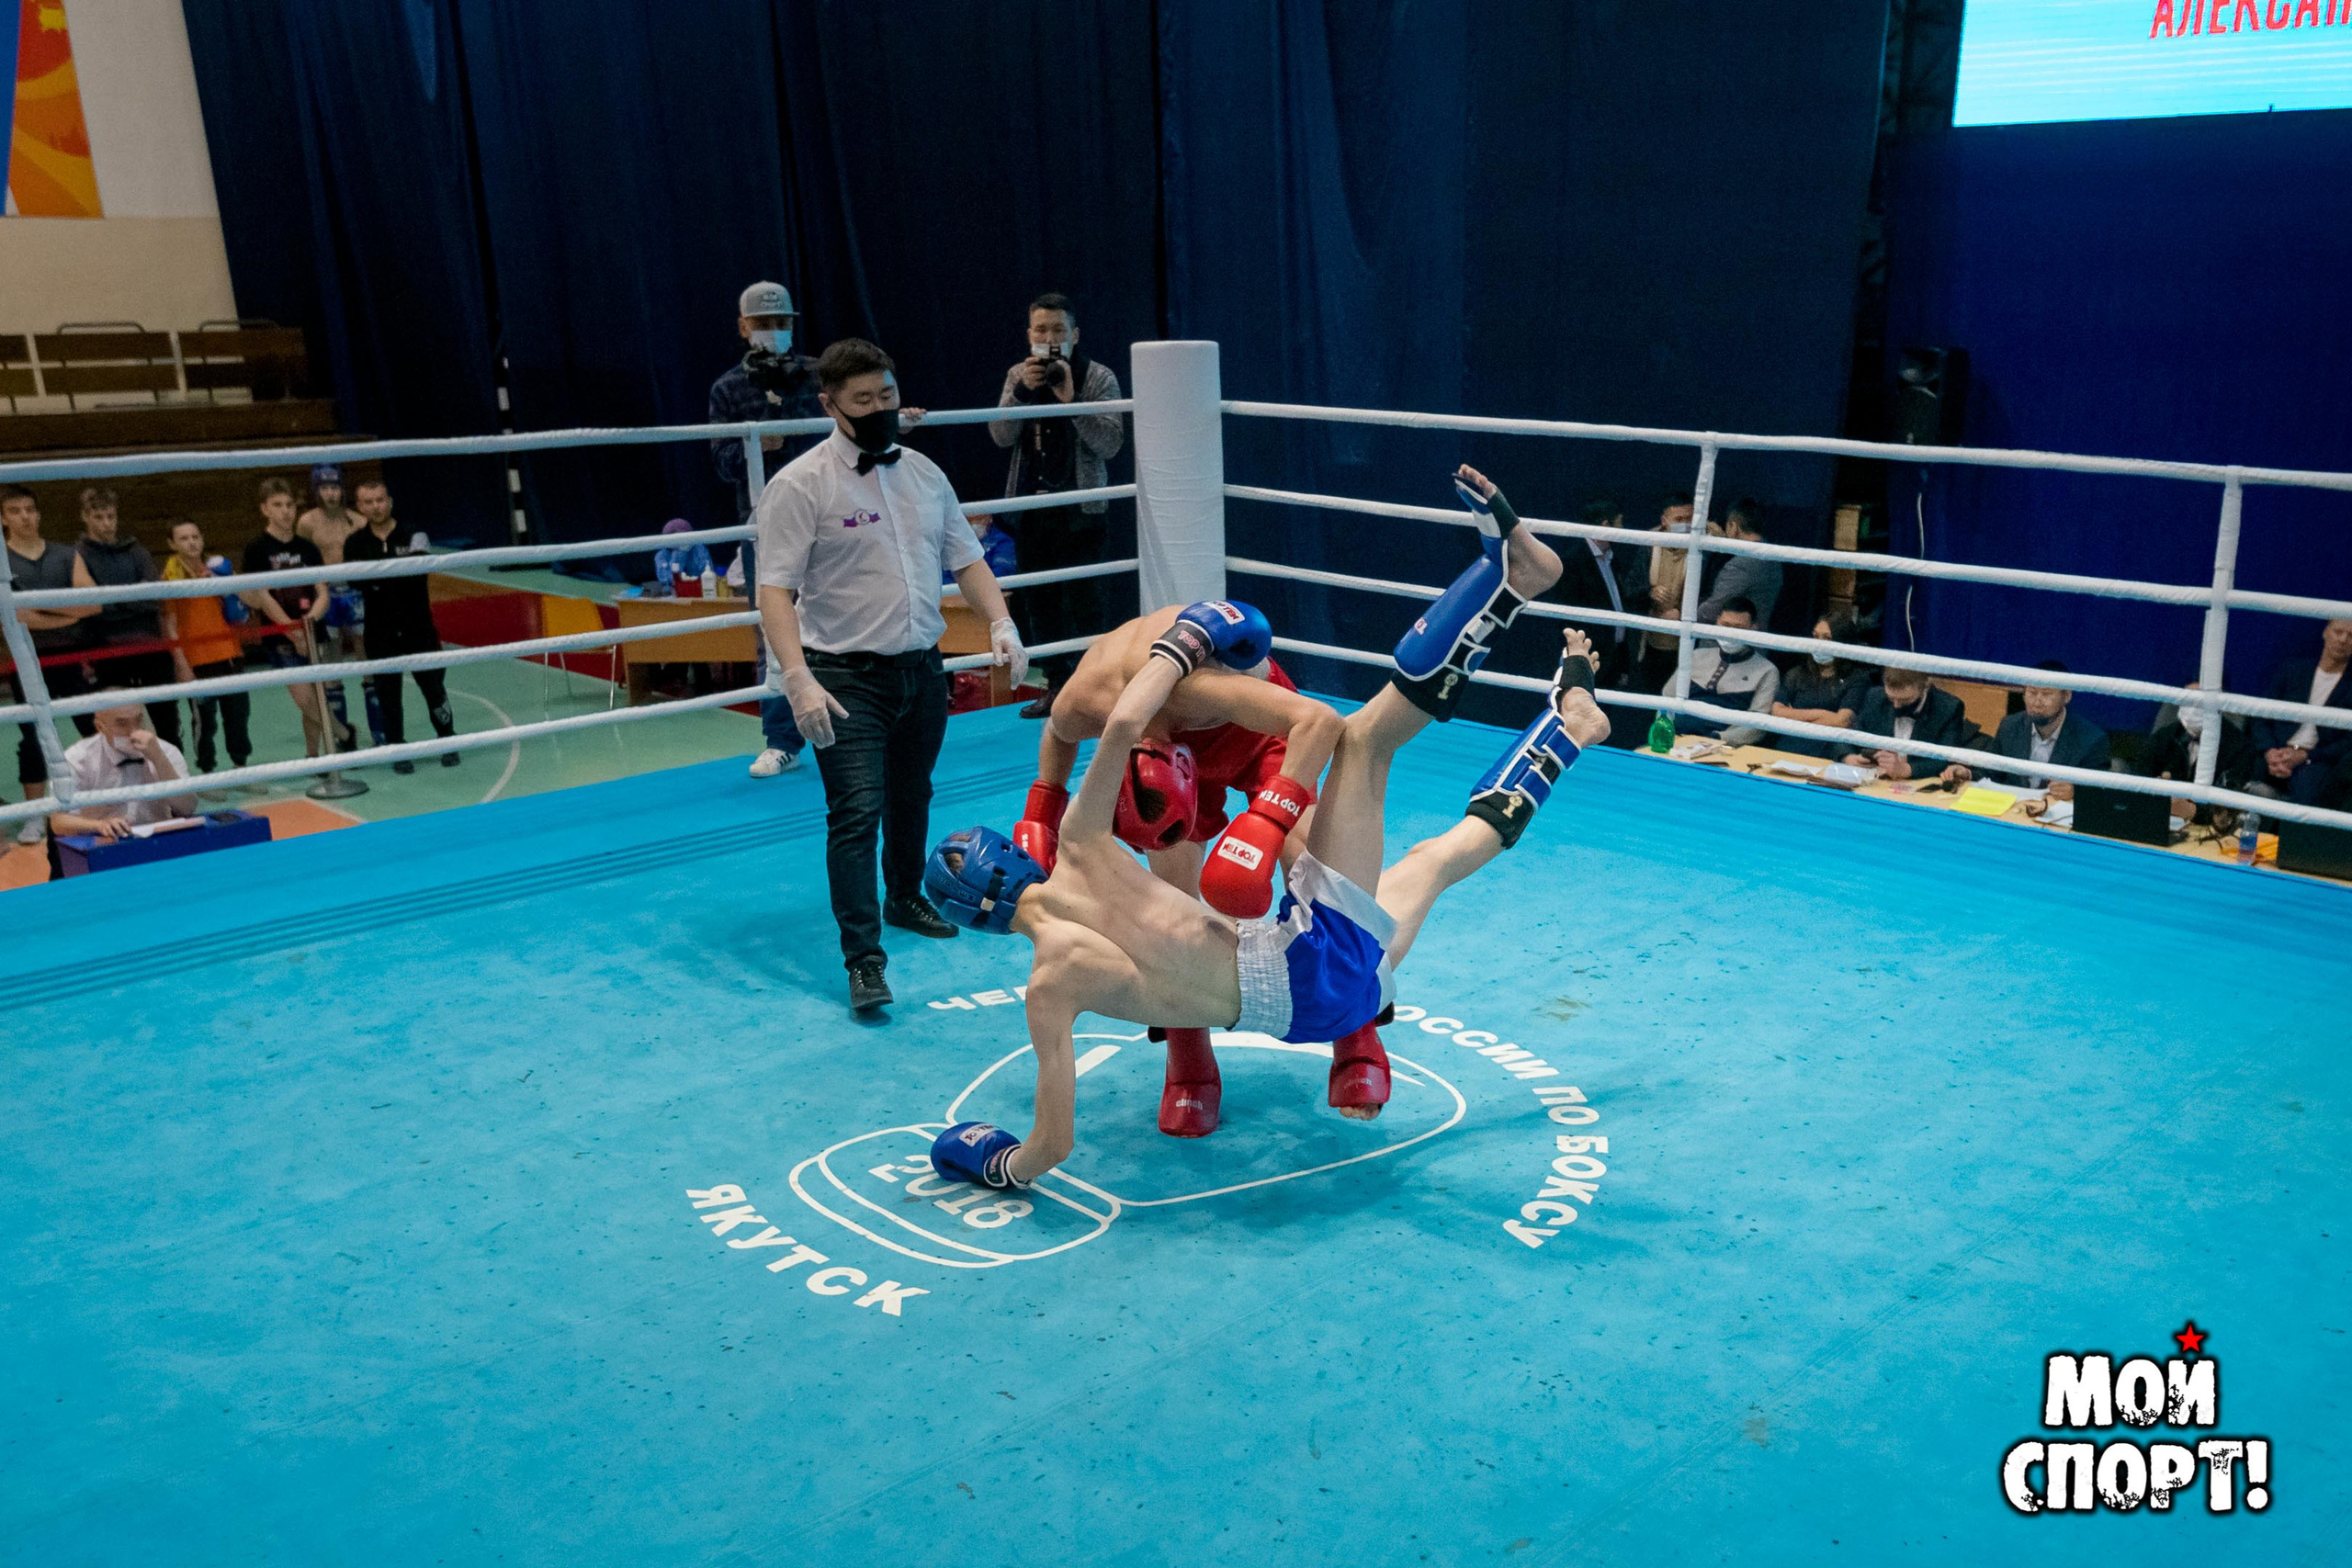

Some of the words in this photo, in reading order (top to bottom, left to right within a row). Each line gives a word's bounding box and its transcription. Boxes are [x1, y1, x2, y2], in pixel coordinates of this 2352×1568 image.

[1177, 629, 1200, 649] TOP
[1259, 789, 1281, 805] TEN
[1280, 797, 1301, 817] TOP
[1222, 842, 1238, 855] TEN
[1238, 849, 1256, 863] TOP
[1394, 1005, 1560, 1080] ОССИИ
[1532, 1086, 1600, 1125] ПО
[867, 1154, 1035, 1229] 2018
[1503, 1134, 1609, 1249] БОКСУ
[685, 1183, 932, 1317] ЯКУТСК
